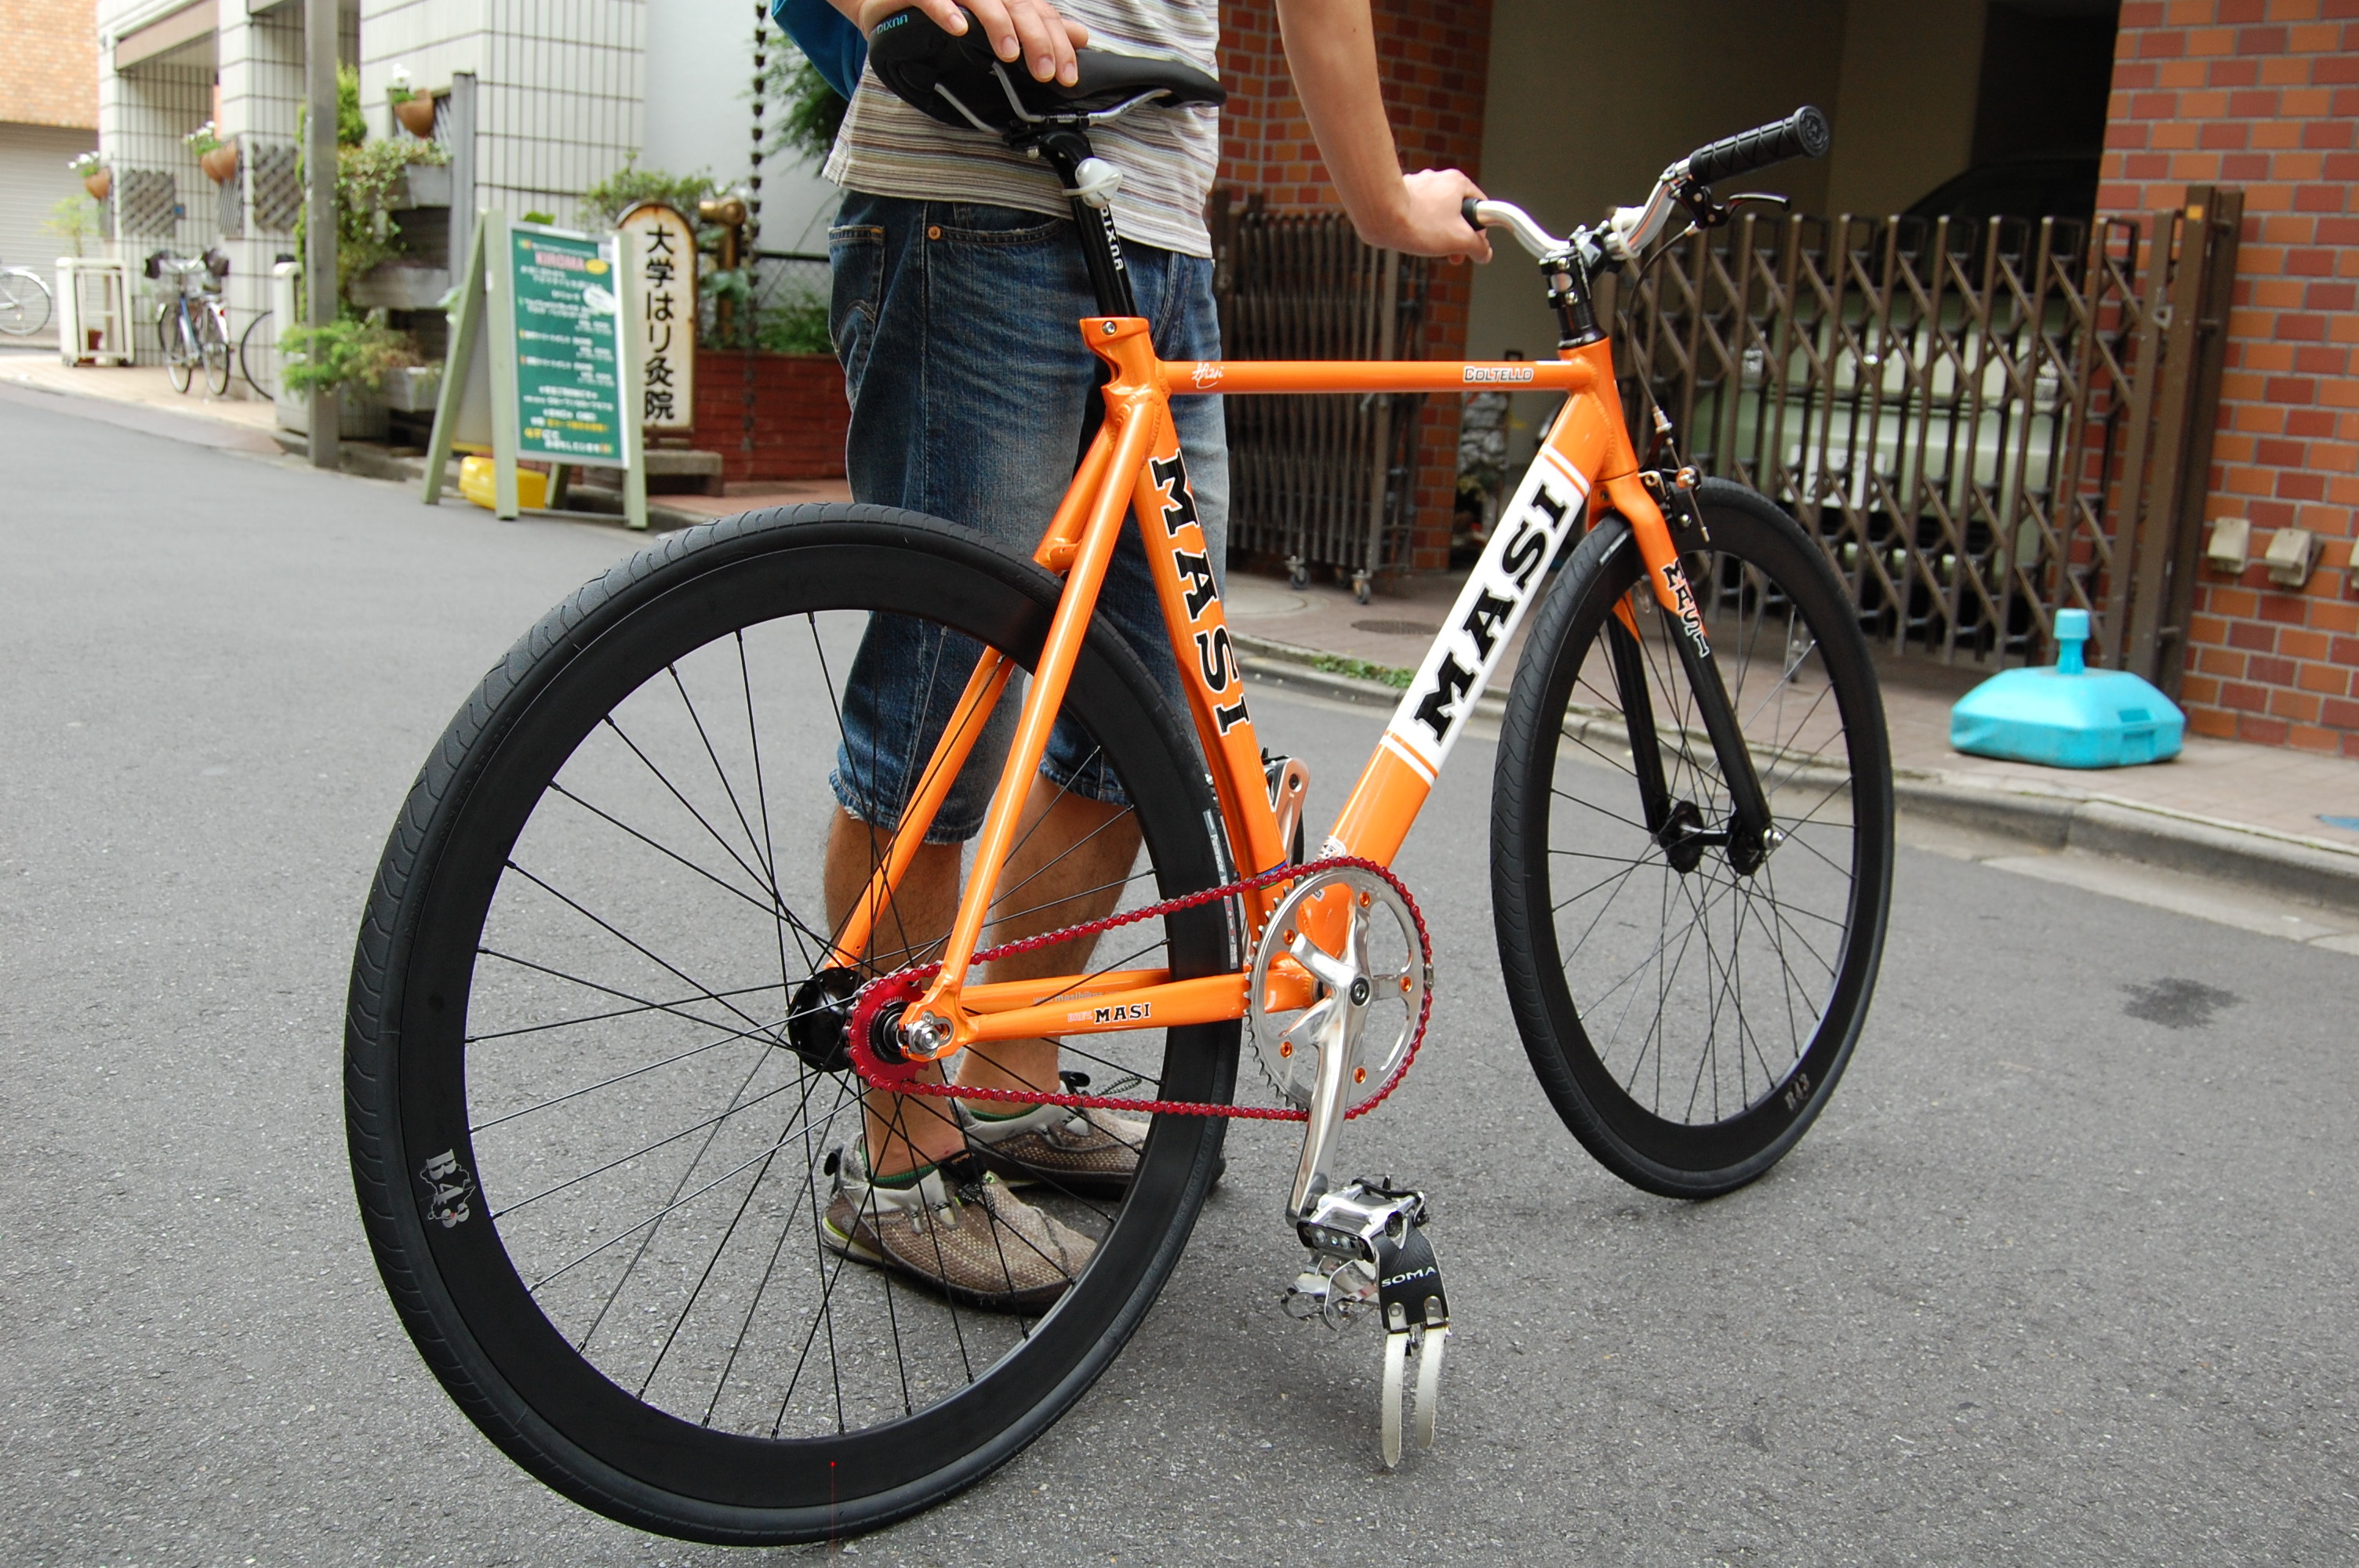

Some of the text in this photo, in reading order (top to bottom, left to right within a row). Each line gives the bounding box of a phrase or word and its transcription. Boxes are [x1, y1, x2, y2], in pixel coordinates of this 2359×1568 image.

[644, 223, 674, 419] 大学はり灸院
[1149, 448, 1251, 736] MASI
[1410, 480, 1570, 746] MASI
[1660, 557, 1710, 659] MASI
[1094, 1002, 1151, 1025] MASI
[1381, 1266, 1437, 1287] SOMA
